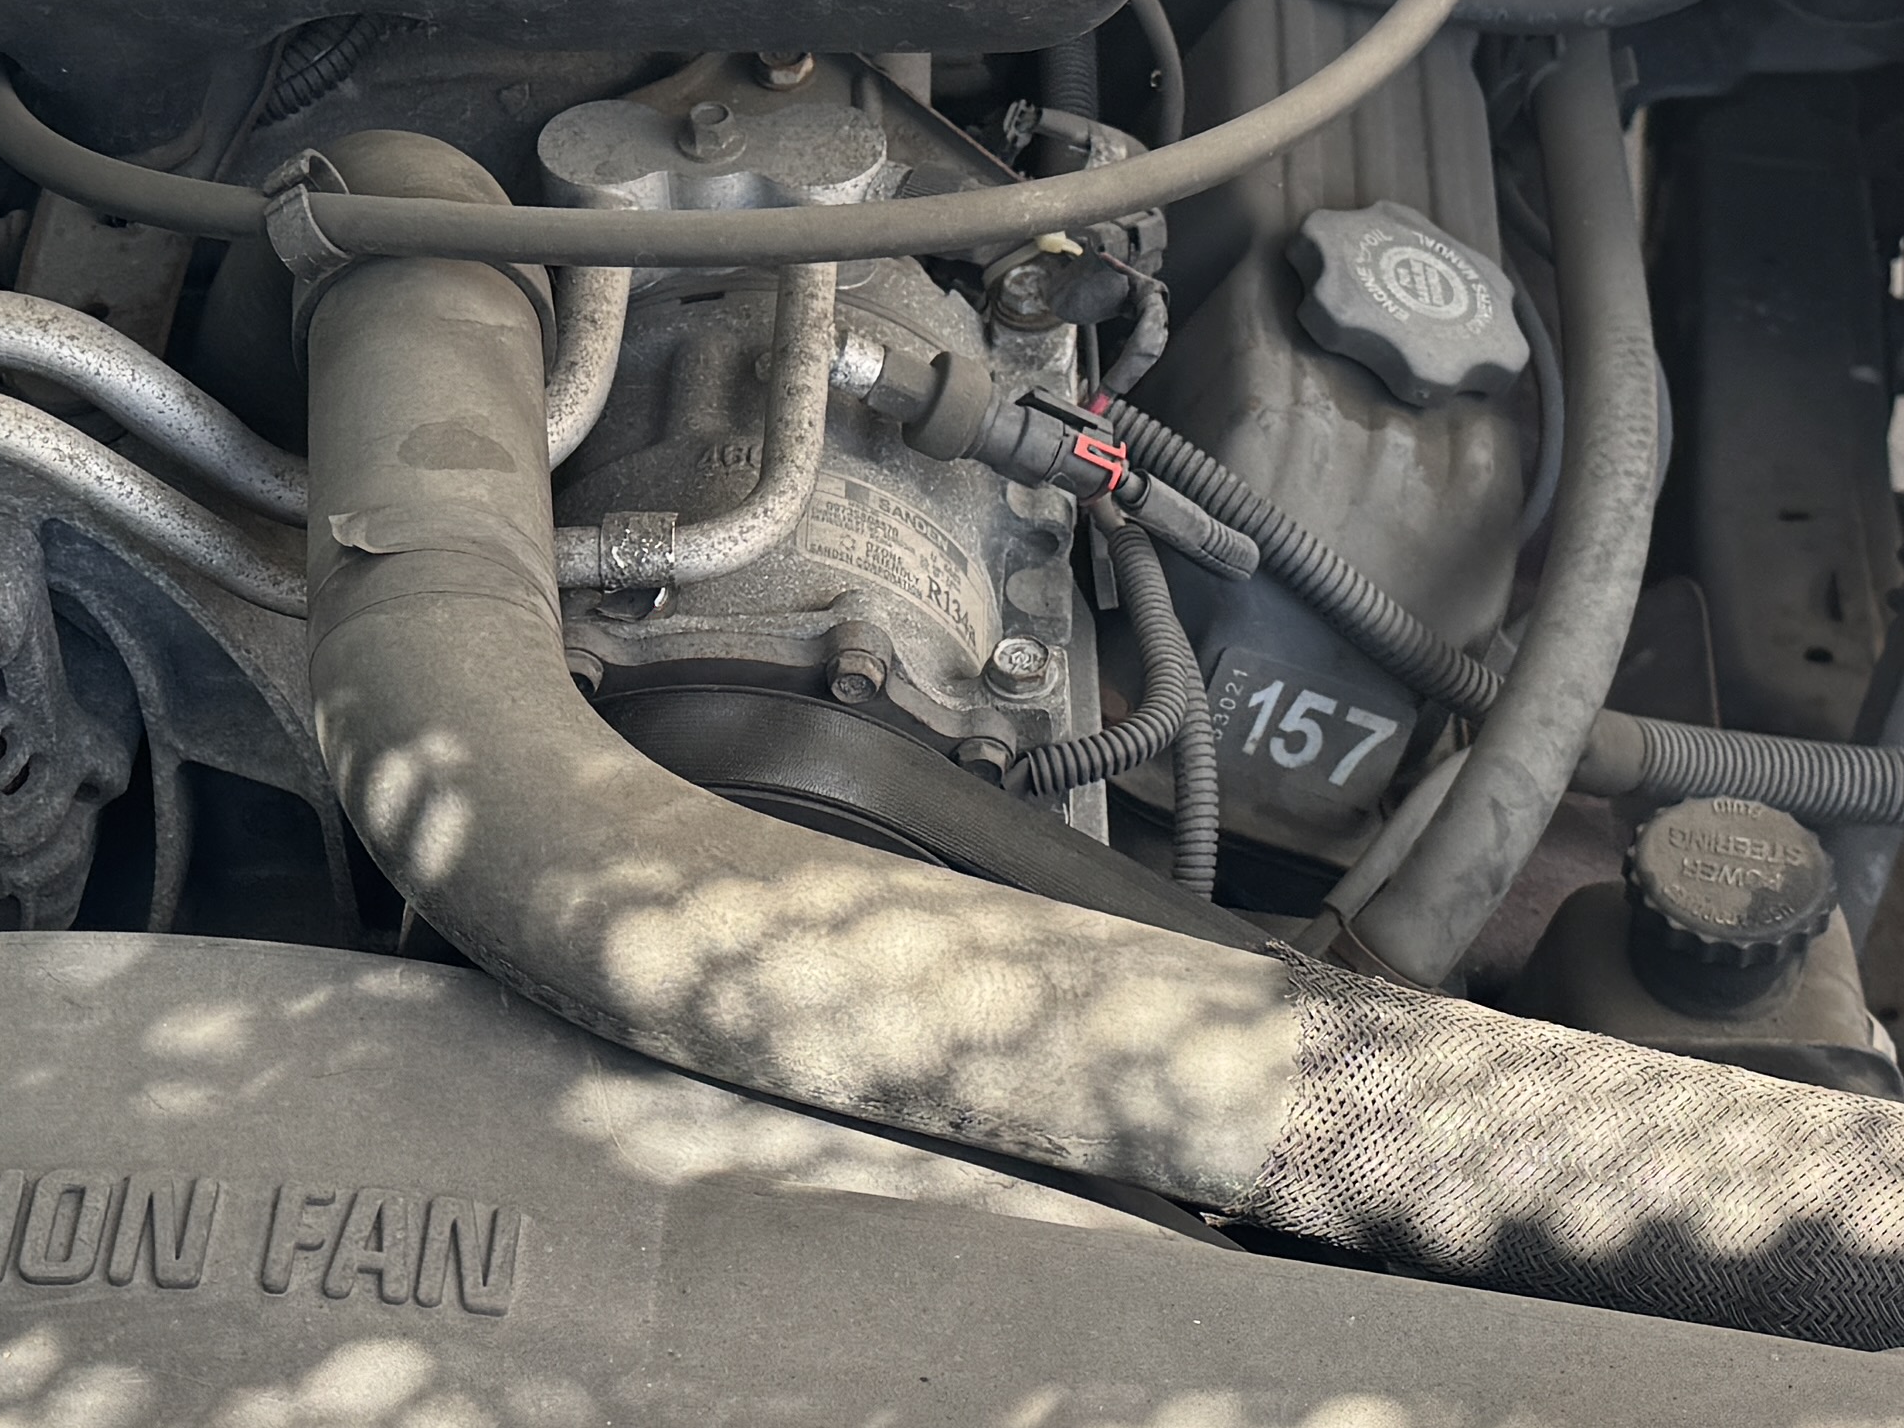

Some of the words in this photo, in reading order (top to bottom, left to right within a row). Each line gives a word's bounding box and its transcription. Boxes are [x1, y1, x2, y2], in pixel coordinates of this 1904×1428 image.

[1362, 228, 1394, 248] OIL
[1411, 230, 1478, 282] MANUAL
[1356, 266, 1411, 324] ENGINE
[878, 498, 949, 551] SANDEN
[1243, 680, 1398, 787] 157
[1668, 827, 1805, 866] STEERING
[1682, 857, 1783, 892] POWER
[260, 1183, 527, 1315] FAN
